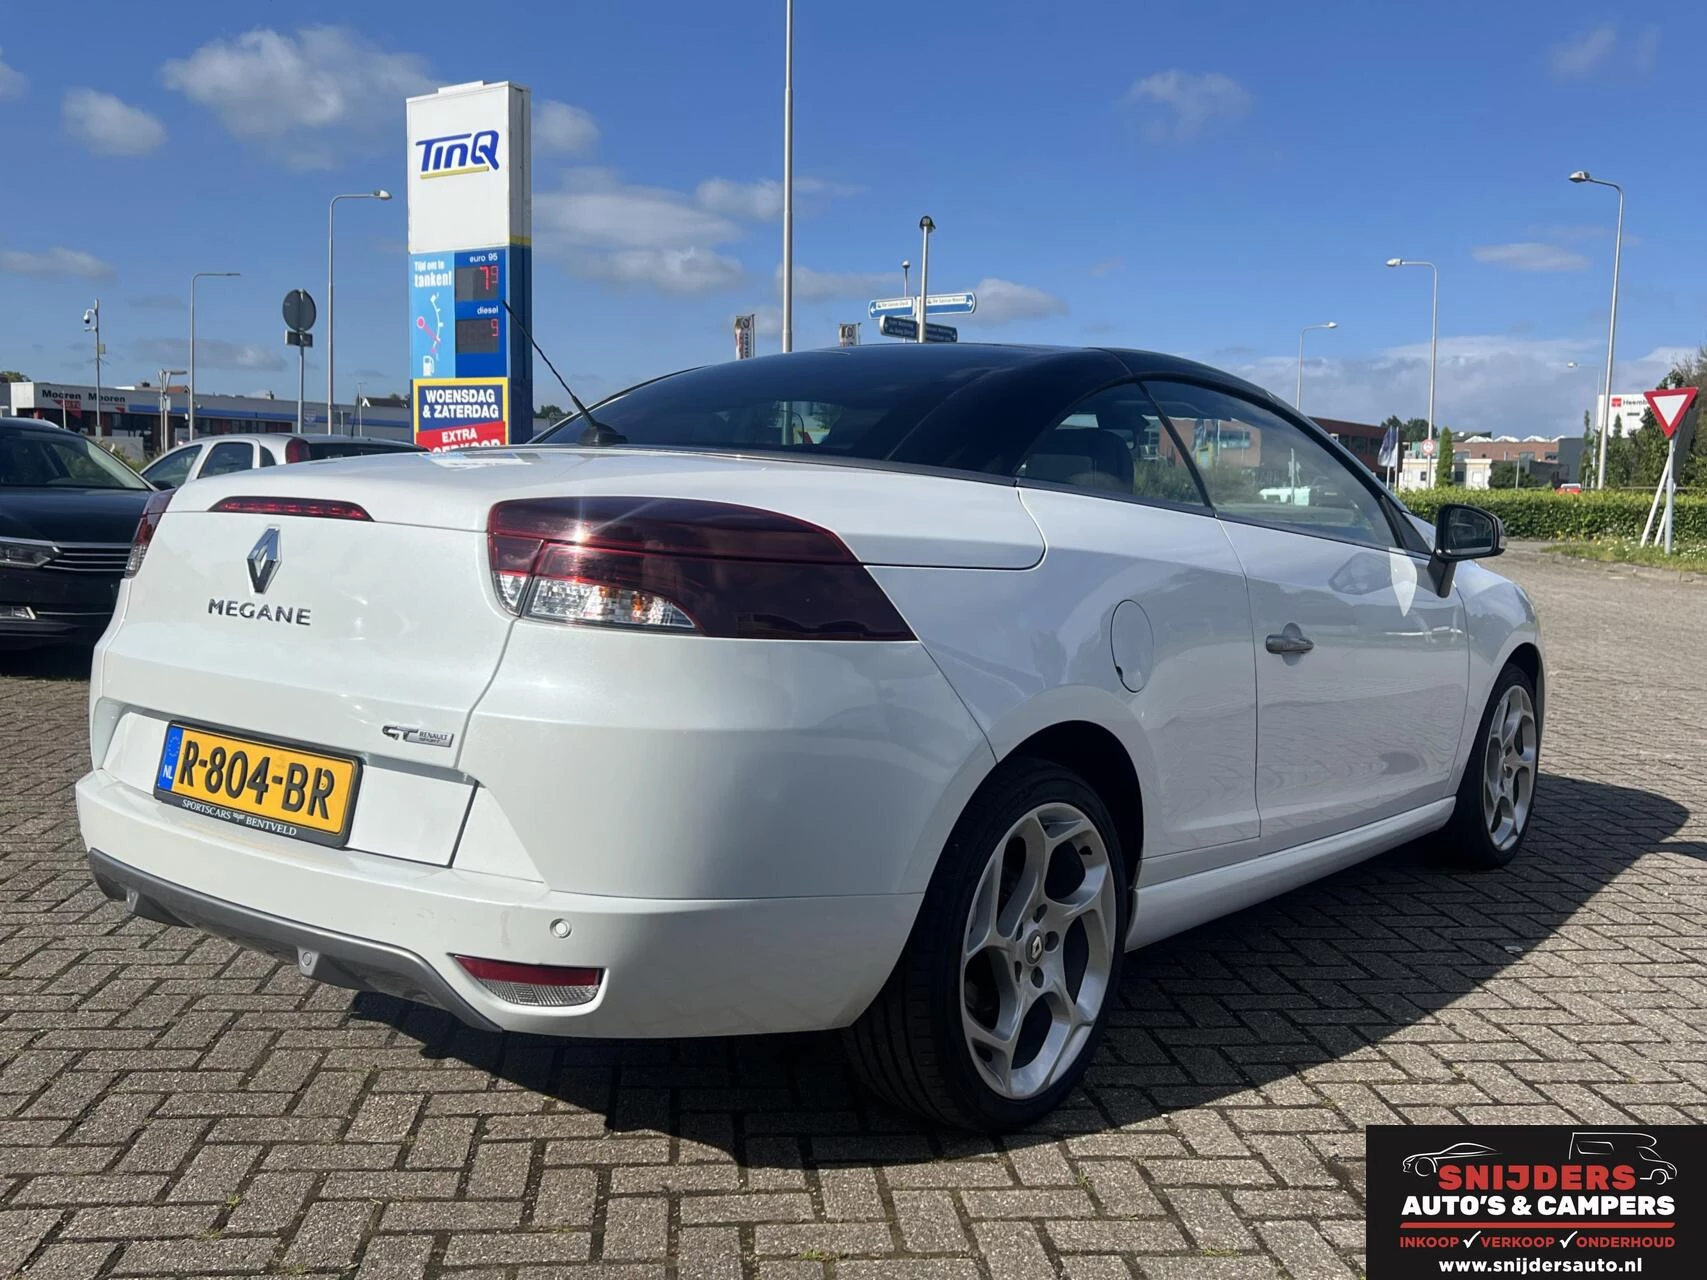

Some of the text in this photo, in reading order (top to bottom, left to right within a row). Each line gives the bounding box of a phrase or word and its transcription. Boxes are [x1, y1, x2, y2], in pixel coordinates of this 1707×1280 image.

[415, 129, 500, 172] TinQ
[469, 252, 498, 263] euro 95
[414, 270, 452, 288] tanken!
[476, 305, 499, 315] diesel
[425, 388, 495, 404] WOENSDAG
[422, 403, 499, 419] & ZATERDAG
[441, 427, 478, 444] EXTRA
[208, 598, 311, 626] MEGANE
[419, 731, 448, 741] RENAULT
[162, 764, 173, 780] NL
[178, 739, 334, 820] R-804-BR
[181, 799, 297, 837] SPORTSCARS BENTVELD
